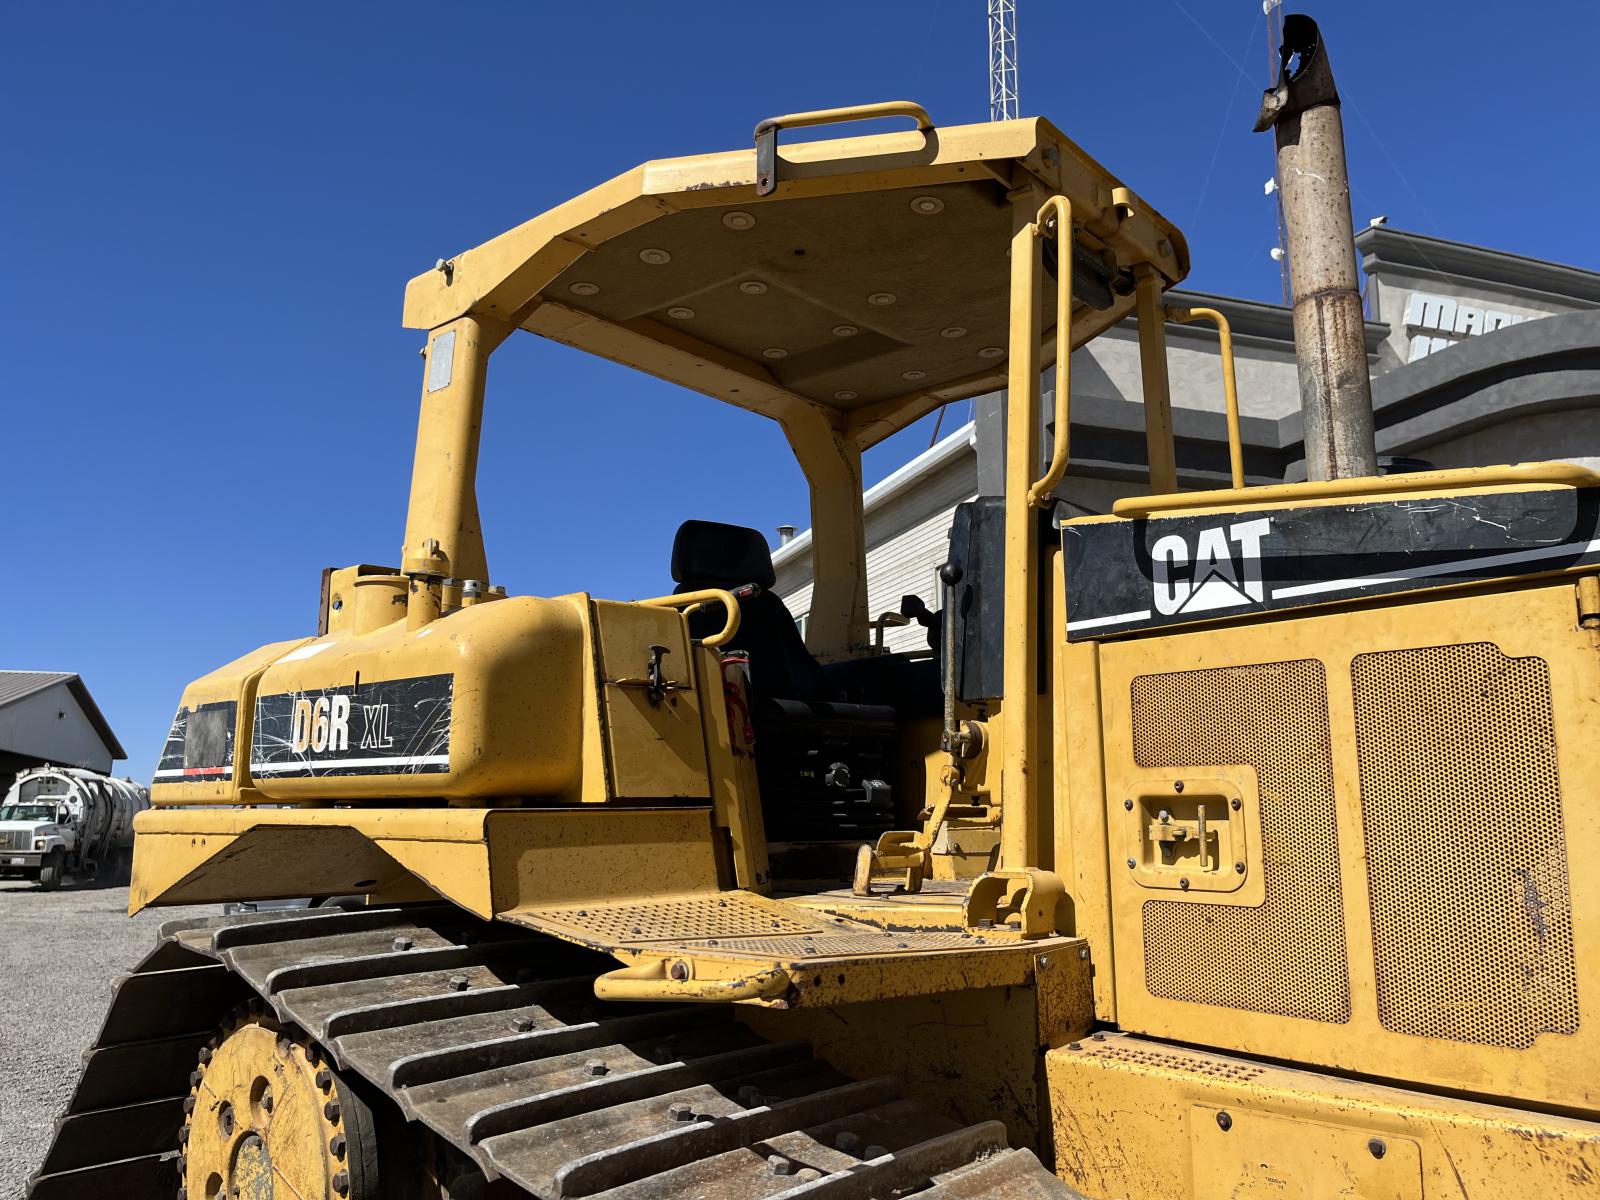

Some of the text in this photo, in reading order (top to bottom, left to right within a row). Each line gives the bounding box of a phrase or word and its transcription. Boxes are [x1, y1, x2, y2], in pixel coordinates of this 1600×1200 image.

[1152, 518, 1270, 615] CAT
[292, 695, 393, 753] D6R XL
